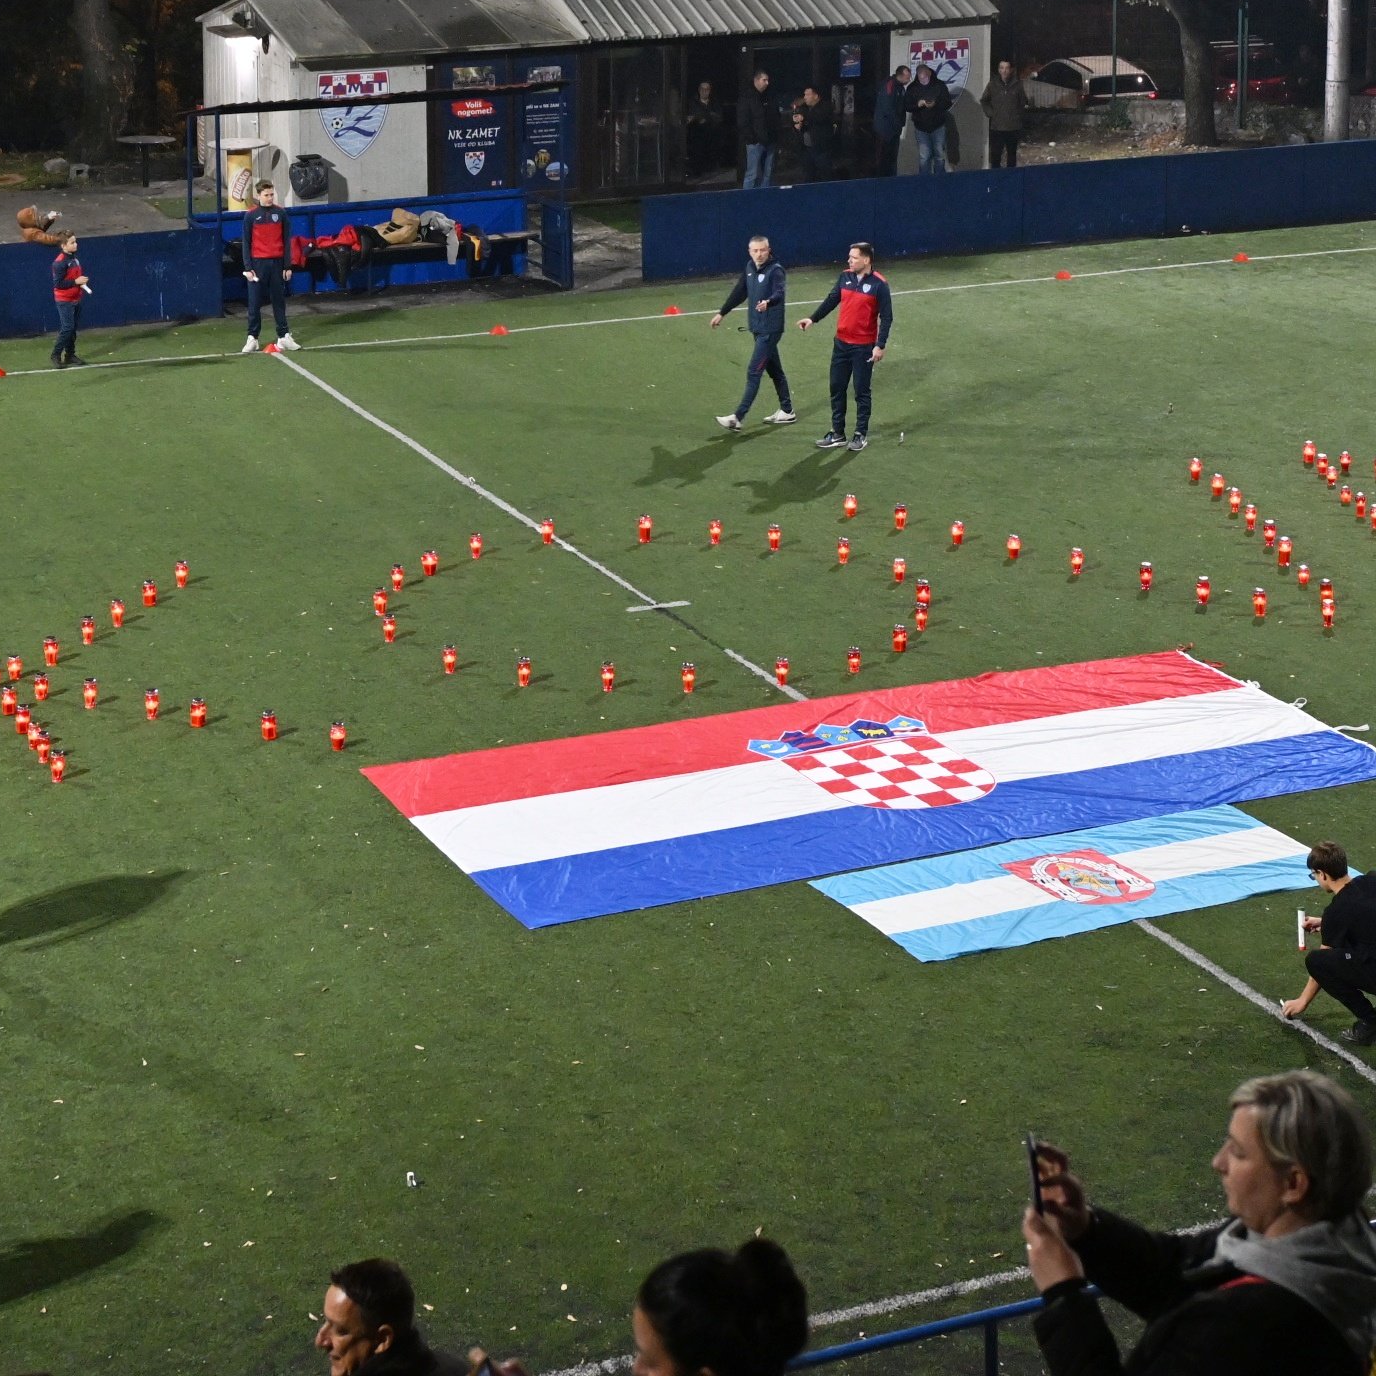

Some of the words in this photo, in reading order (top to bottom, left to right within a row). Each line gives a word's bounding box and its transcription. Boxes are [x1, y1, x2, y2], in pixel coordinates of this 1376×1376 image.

[465, 101, 482, 109] Voliš
[457, 107, 493, 117] nogomet?
[448, 129, 463, 140] NK
[465, 126, 501, 139] ZAMET
